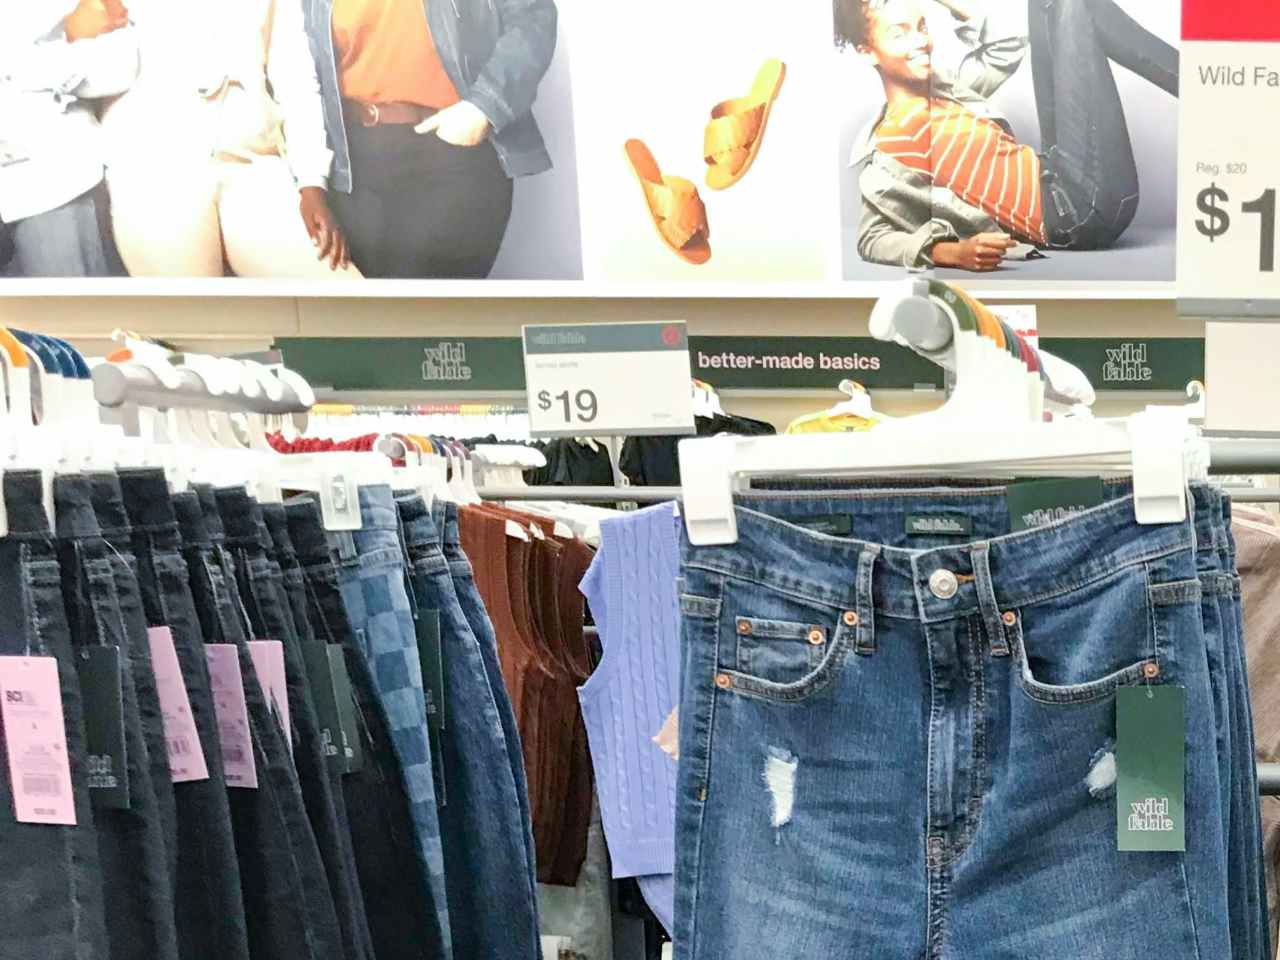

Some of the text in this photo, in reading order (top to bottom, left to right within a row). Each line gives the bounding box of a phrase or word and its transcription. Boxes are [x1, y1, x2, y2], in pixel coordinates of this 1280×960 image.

[1198, 66, 1245, 87] Wild
[1226, 163, 1247, 174] $20
[698, 351, 881, 370] better-made basics
[1105, 343, 1147, 363] wild
[1102, 360, 1152, 382] fable
[537, 388, 598, 423] $19
[1131, 797, 1169, 816] wild
[1128, 813, 1174, 831] fable
